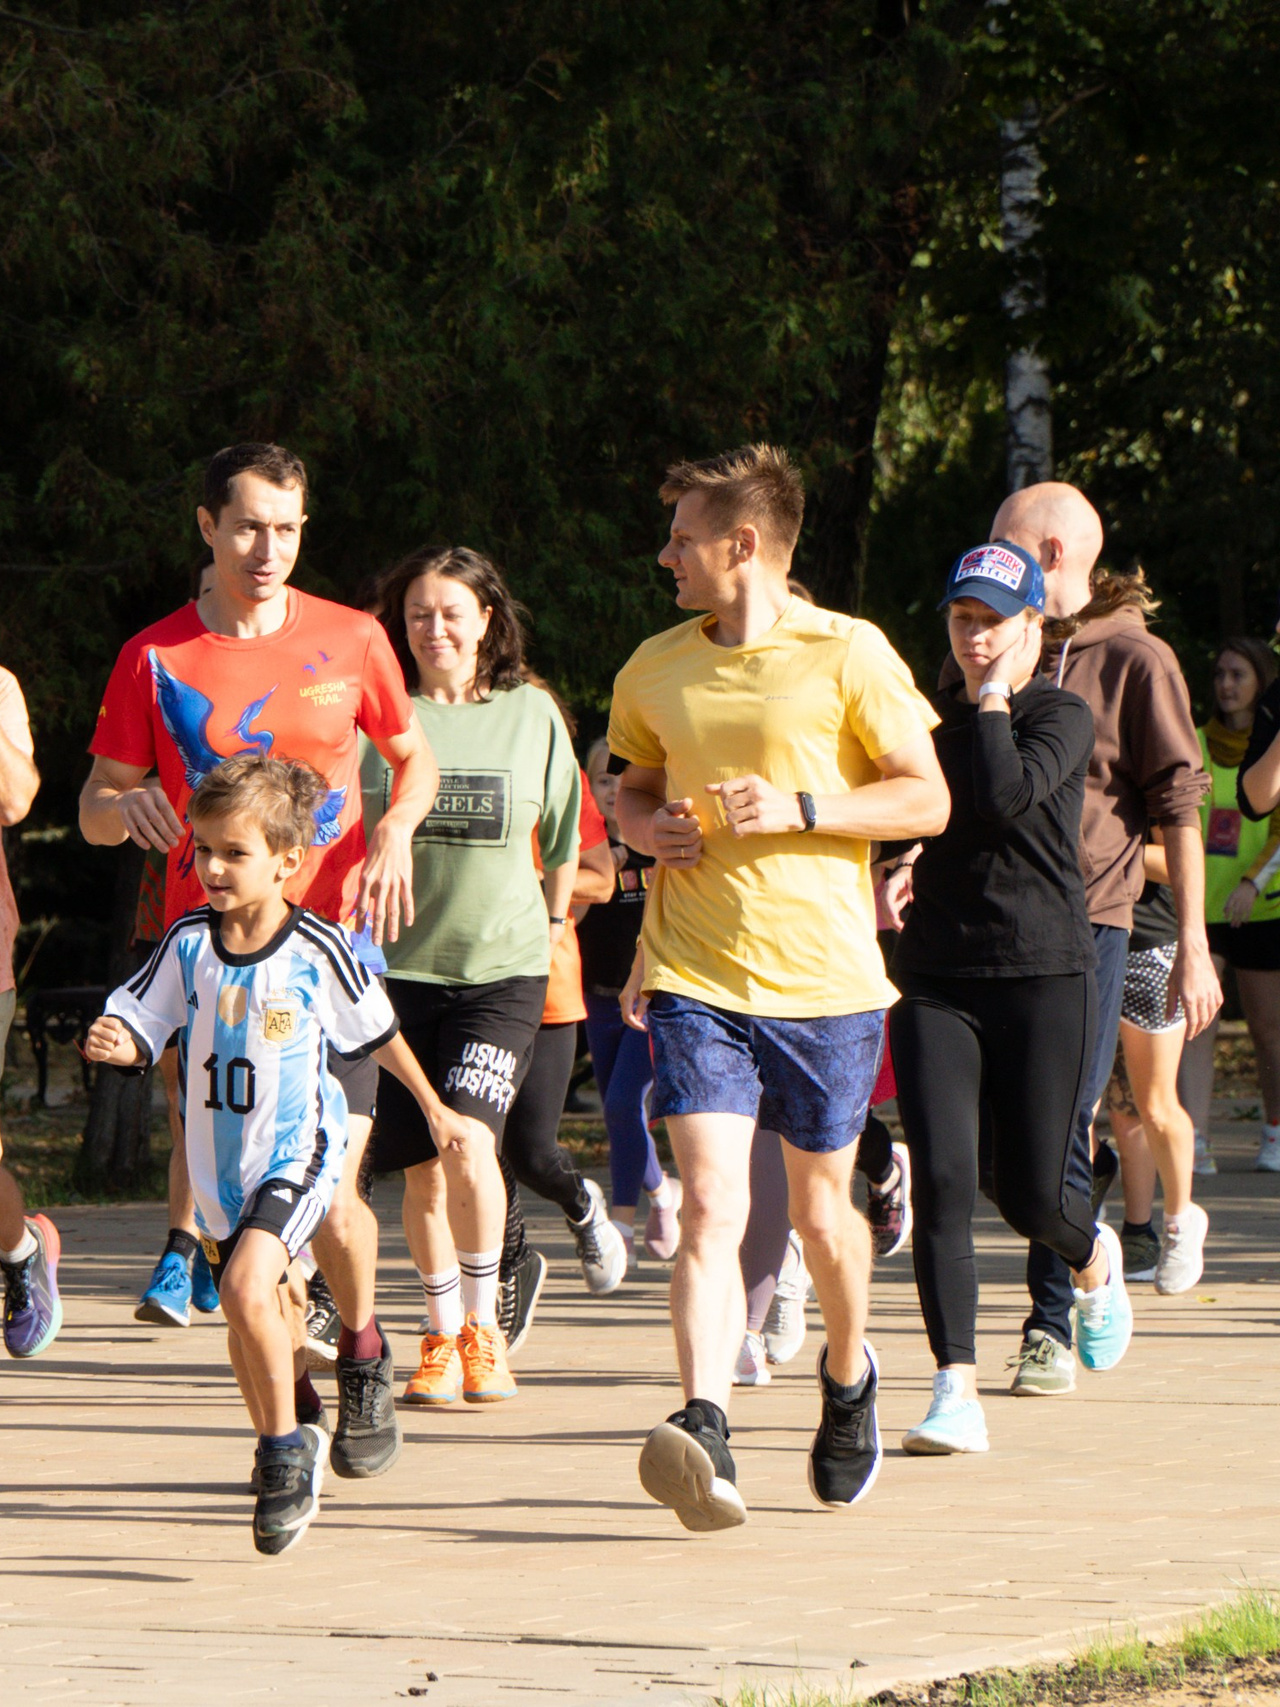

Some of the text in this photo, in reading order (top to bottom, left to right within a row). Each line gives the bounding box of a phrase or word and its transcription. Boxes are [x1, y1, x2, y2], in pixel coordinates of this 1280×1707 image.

[962, 547, 1022, 574] NEW YORK
[299, 680, 347, 698] UGRESHA
[311, 693, 343, 707] TRAIL
[268, 1011, 292, 1034] AFA
[461, 1041, 517, 1080] USUAL
[202, 1052, 256, 1115] 10
